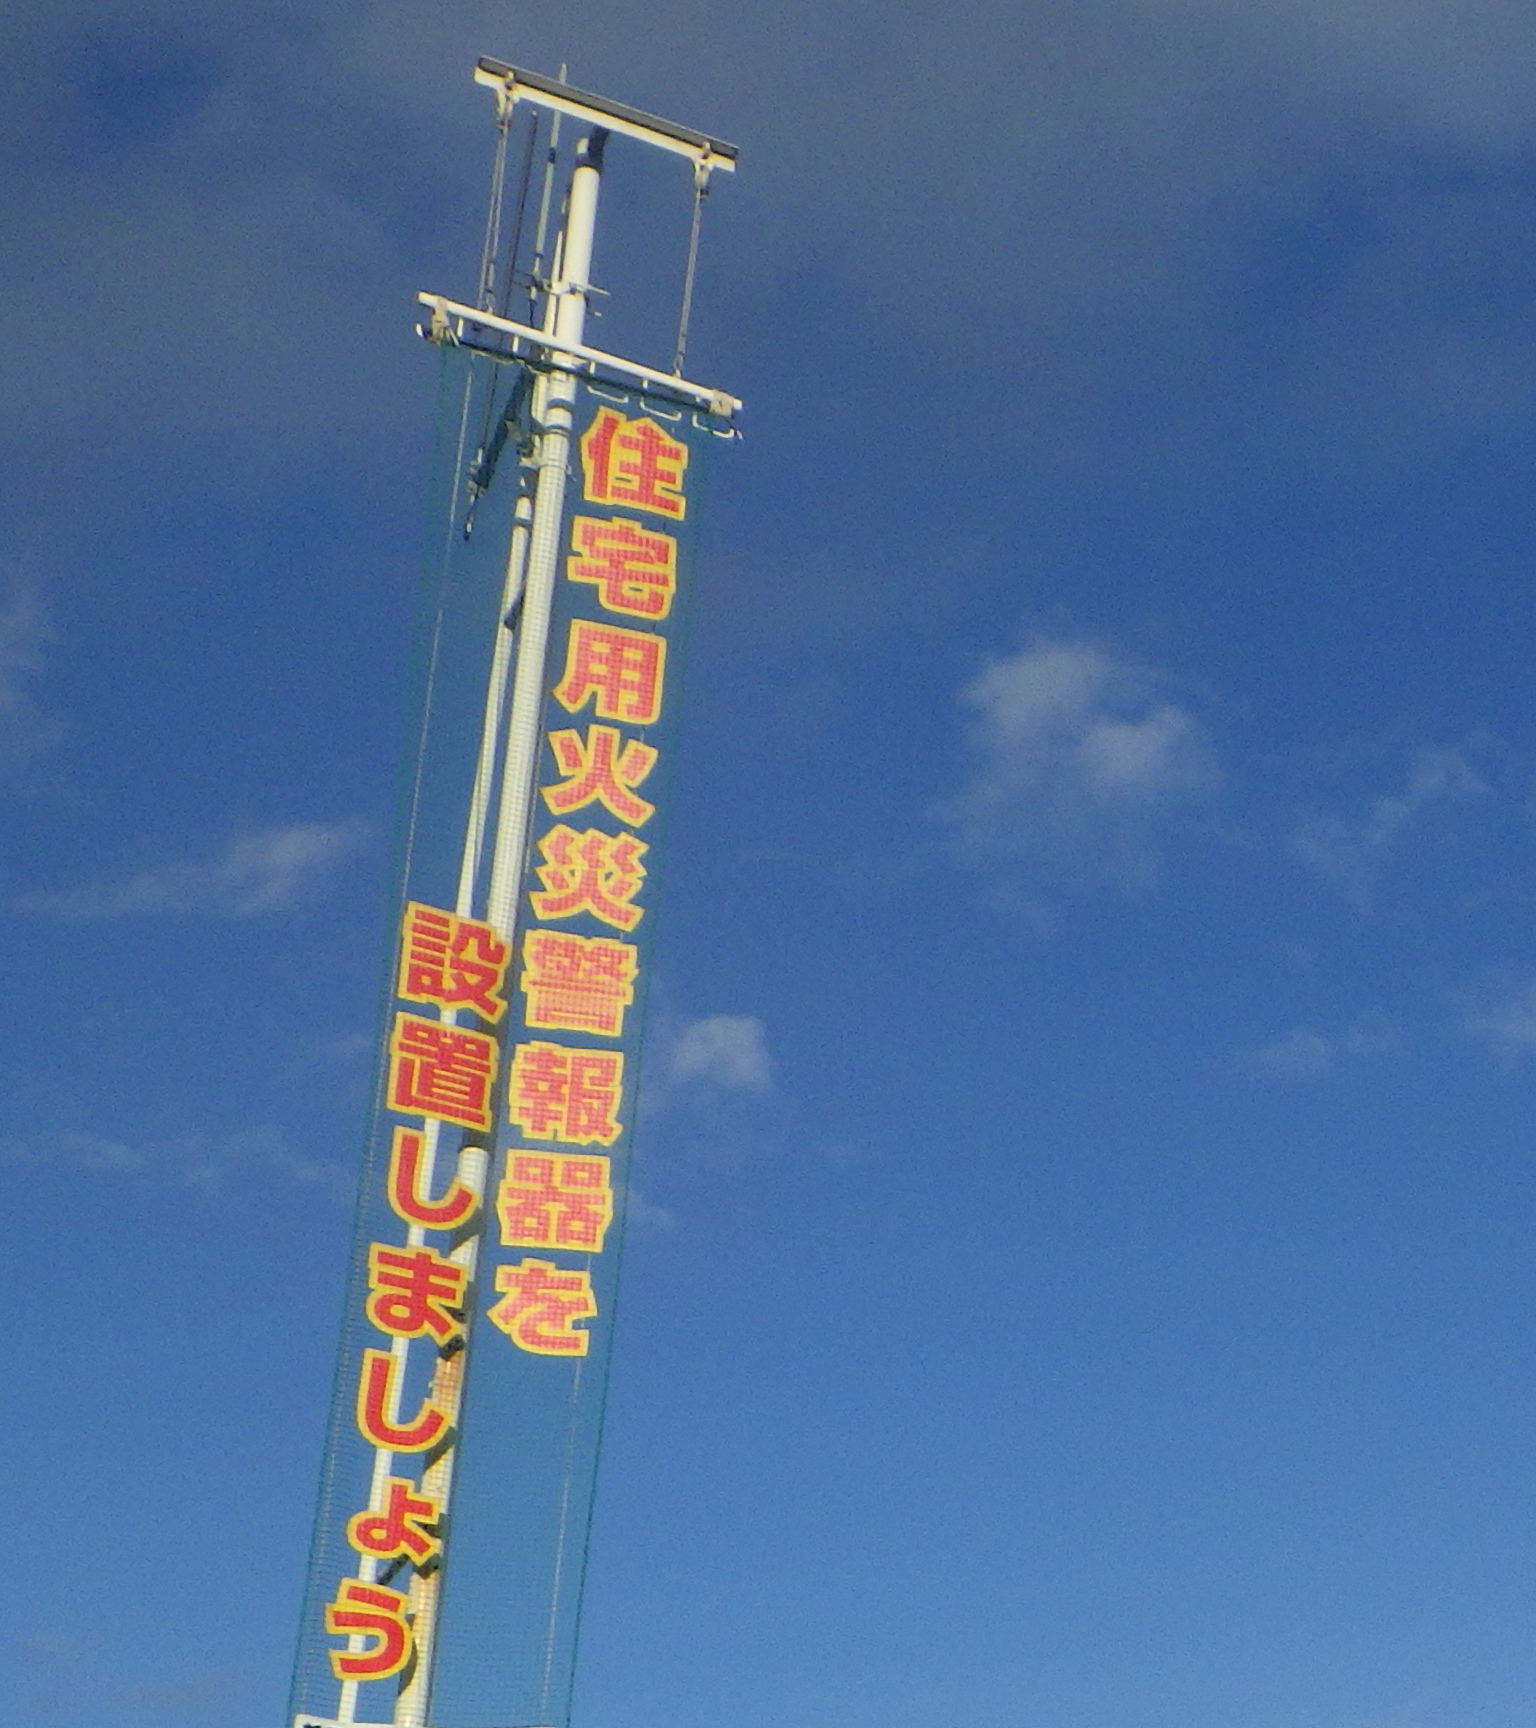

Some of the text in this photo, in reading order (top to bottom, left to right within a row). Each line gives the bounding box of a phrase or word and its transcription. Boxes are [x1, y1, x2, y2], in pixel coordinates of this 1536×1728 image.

[325, 900, 512, 1685] 設置しましょう
[487, 405, 688, 1357] 住宅用火災警報器を
